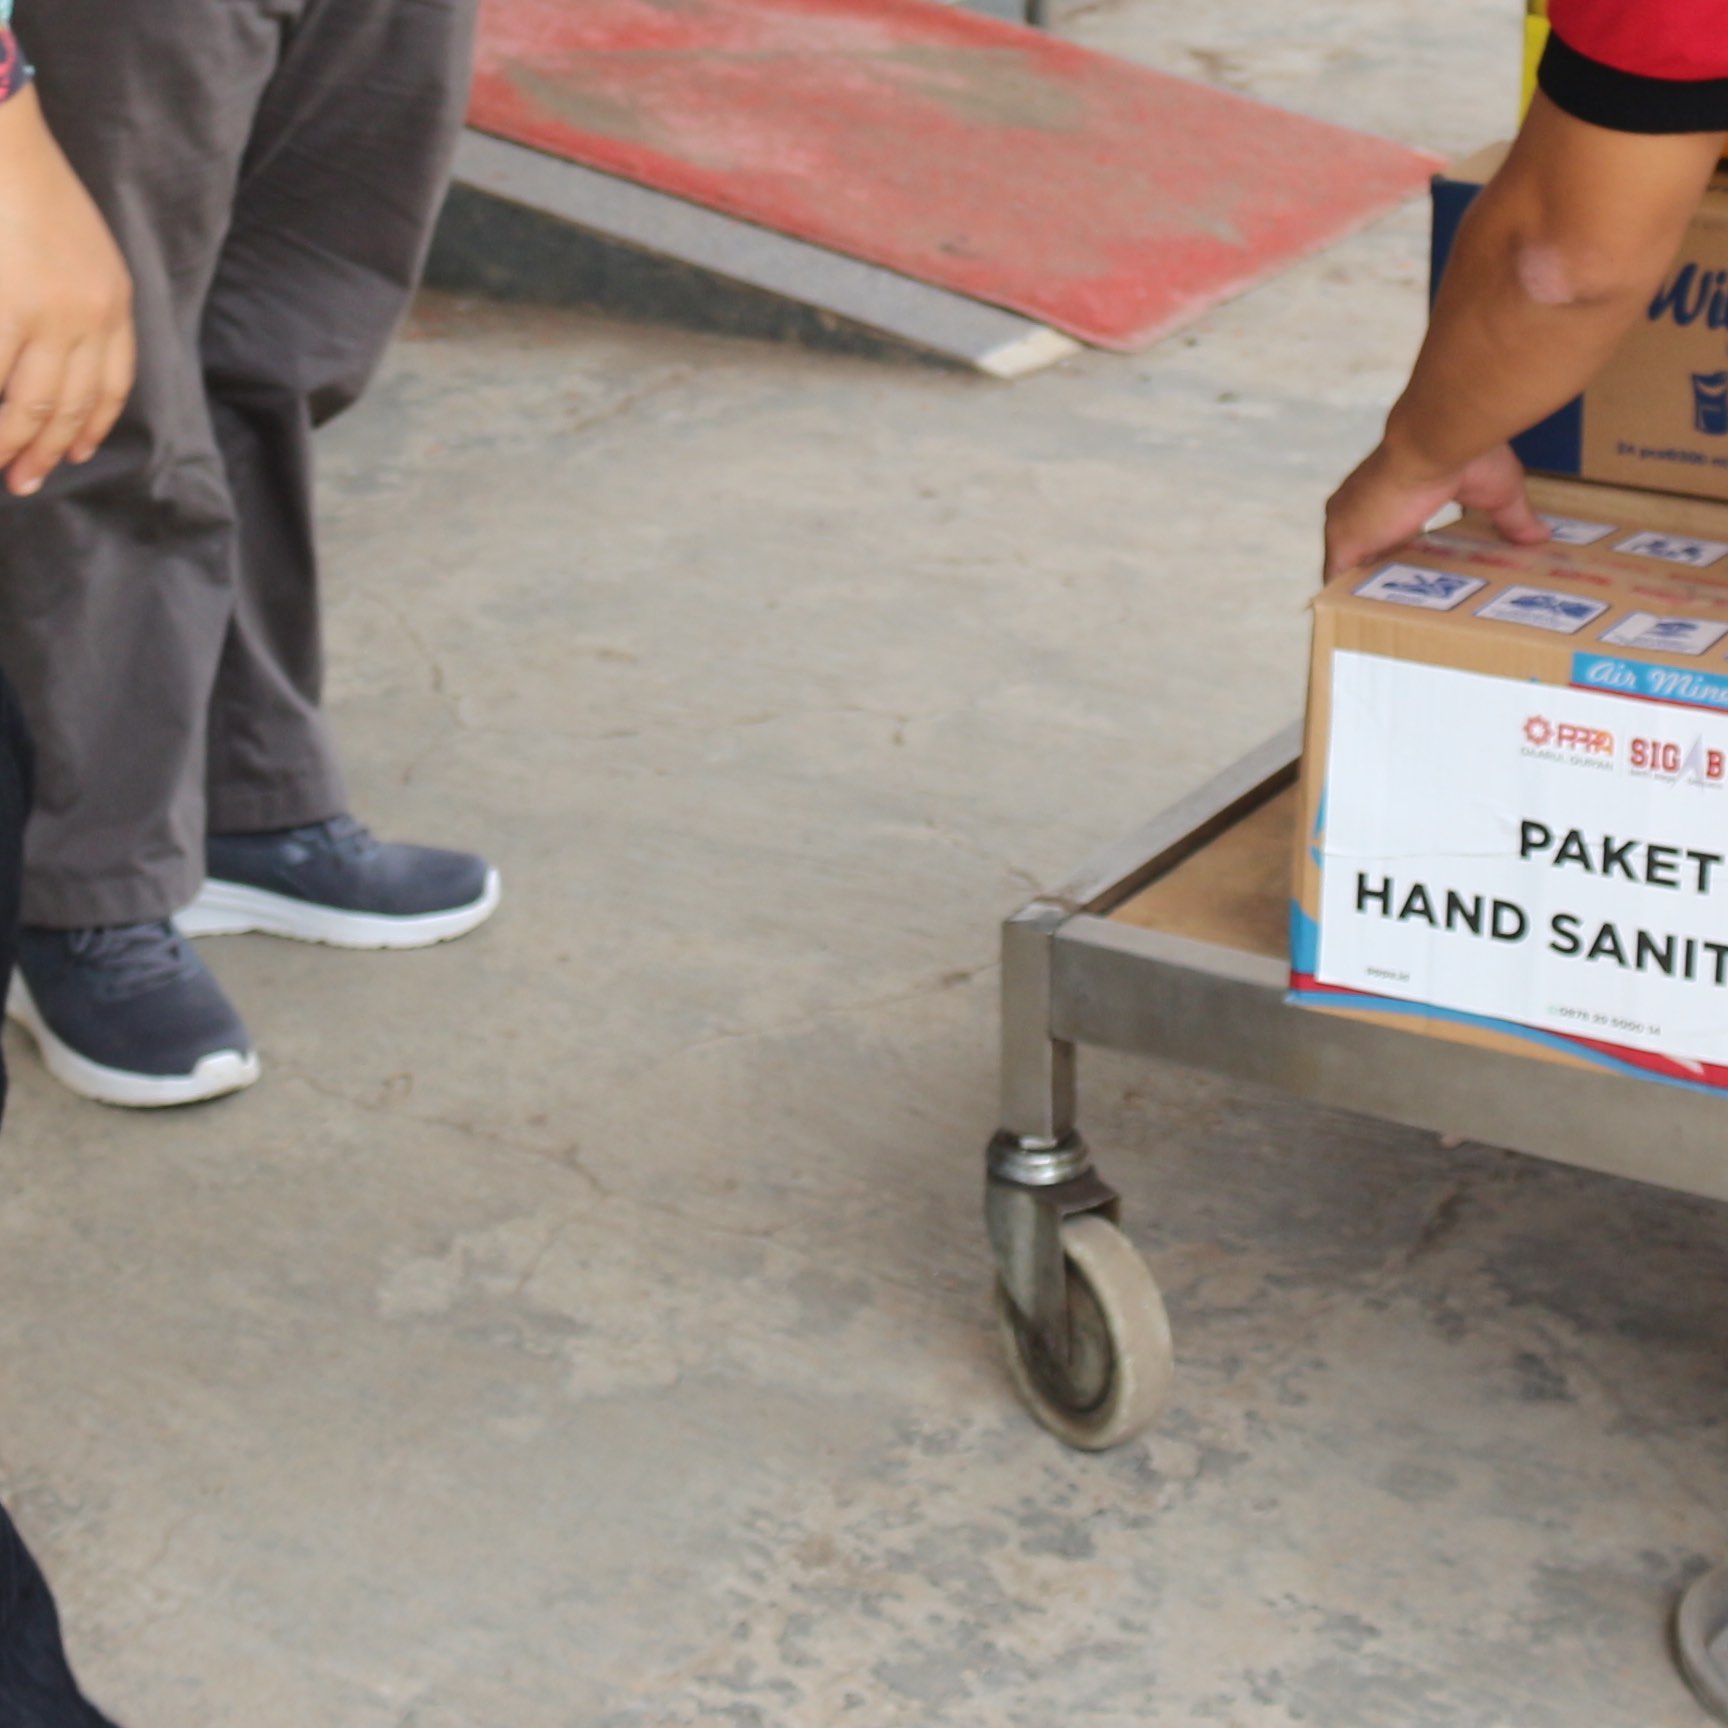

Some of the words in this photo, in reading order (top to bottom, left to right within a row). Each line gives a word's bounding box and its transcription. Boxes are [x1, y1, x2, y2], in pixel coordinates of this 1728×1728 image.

[1586, 661, 1638, 689] Air
[1518, 821, 1723, 895] PAKET
[1355, 873, 1528, 944] HAND
